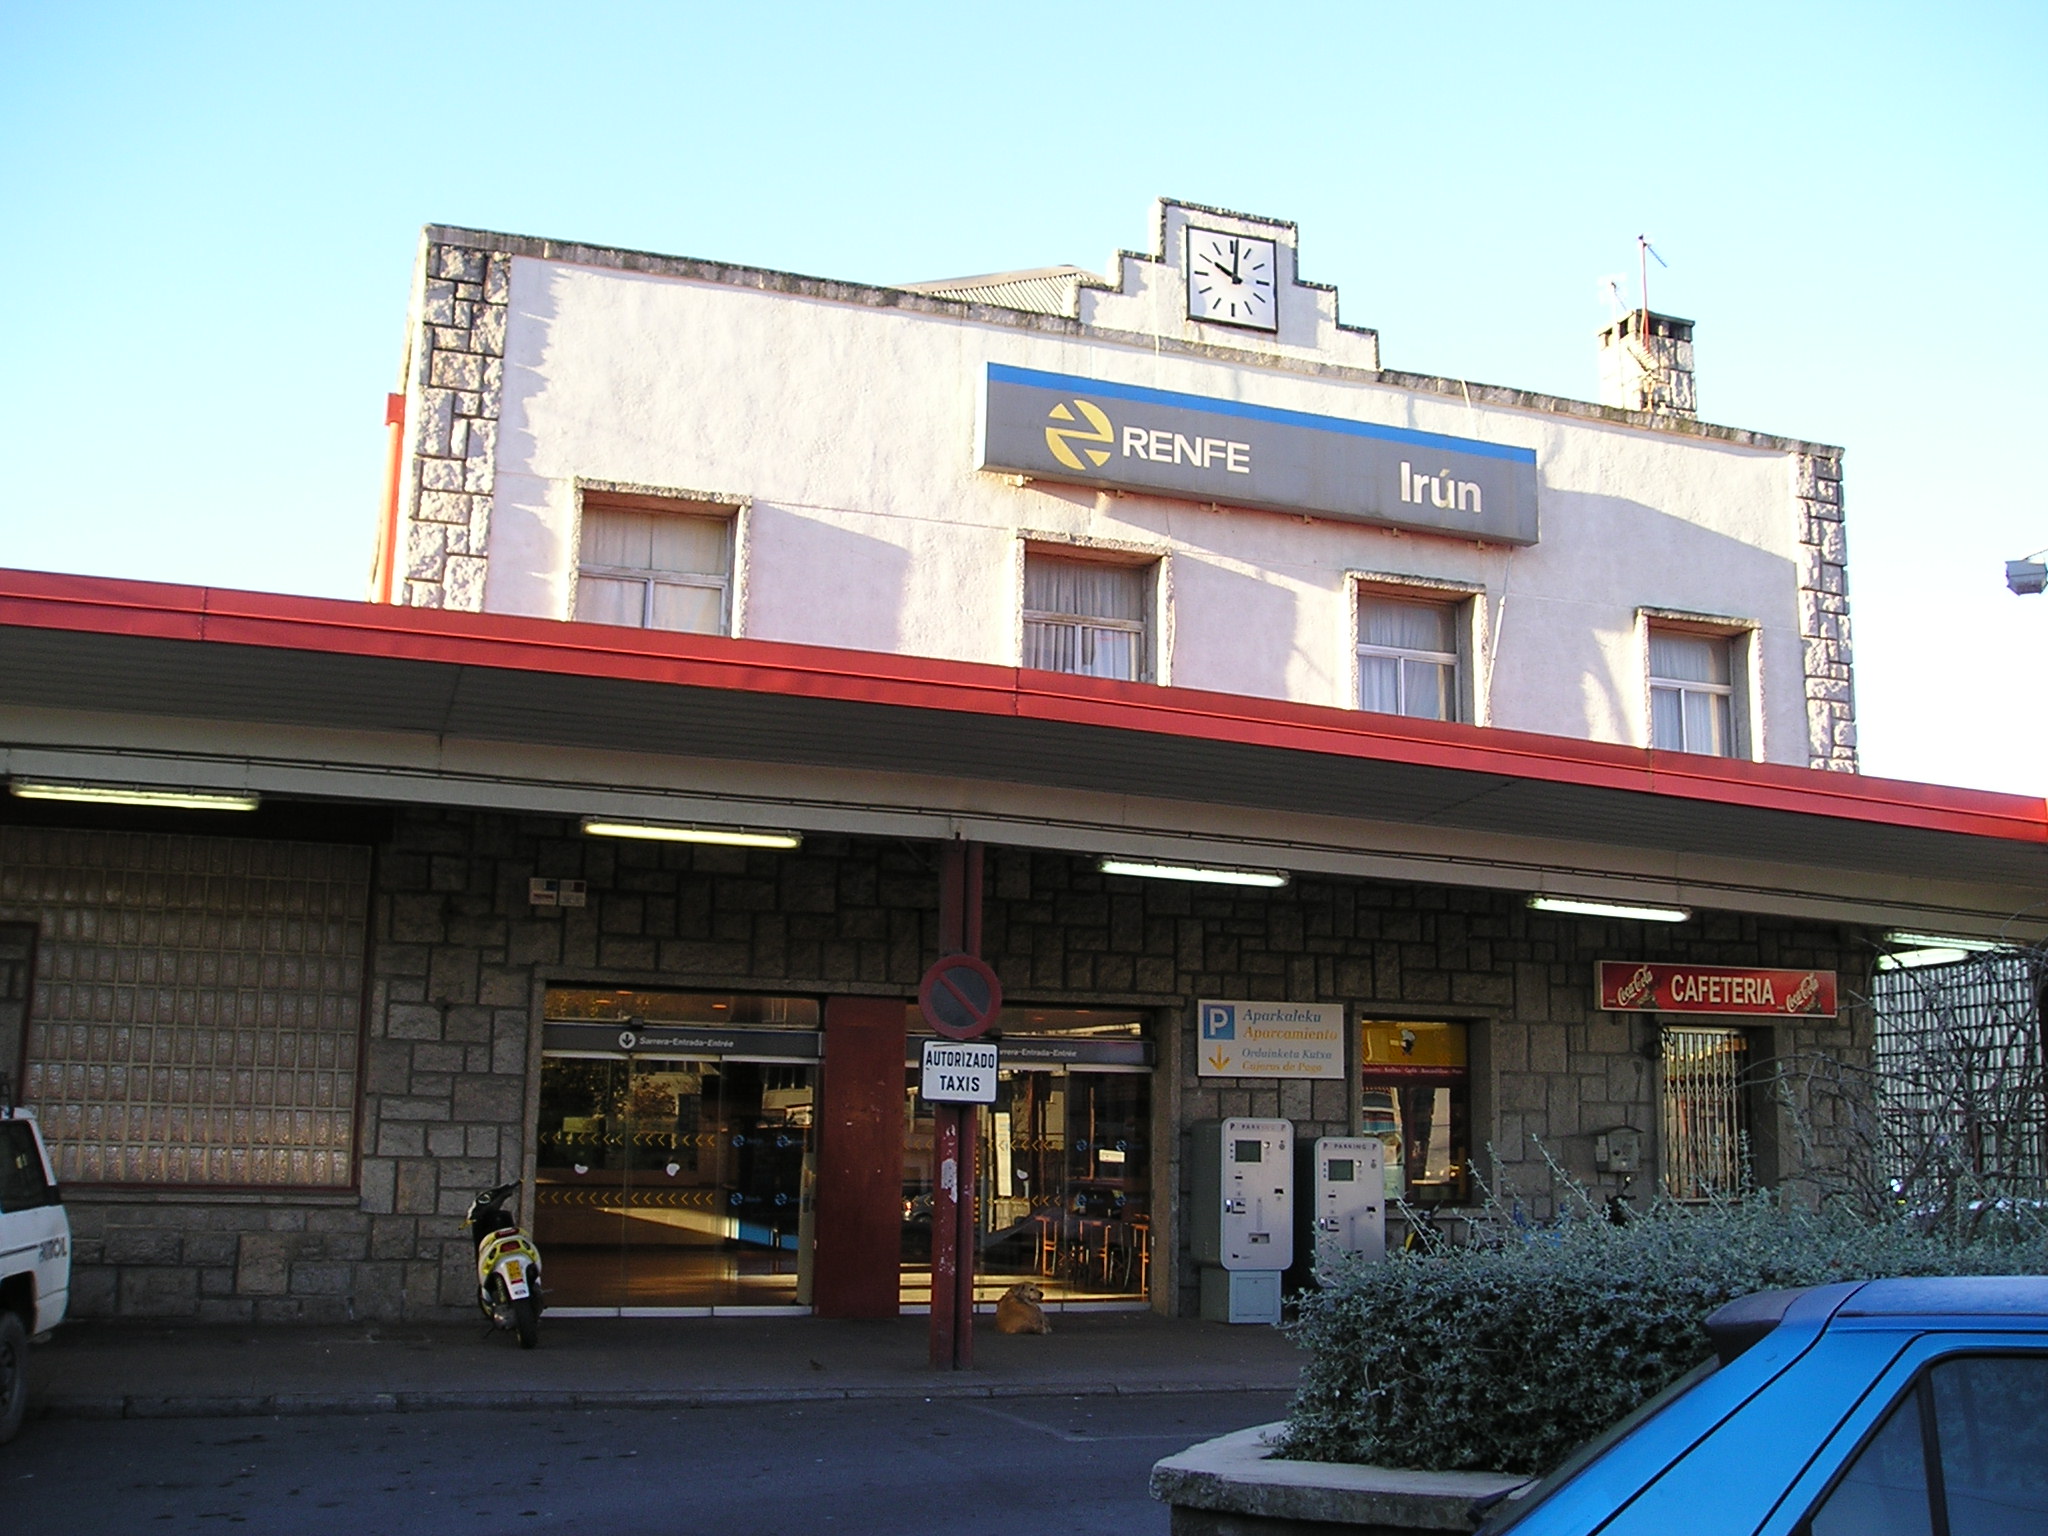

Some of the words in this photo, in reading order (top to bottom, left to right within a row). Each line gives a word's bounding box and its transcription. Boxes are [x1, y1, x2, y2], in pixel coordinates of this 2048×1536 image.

[1123, 425, 1250, 474] RENFE
[1400, 460, 1482, 513] Irún
[1671, 974, 1776, 1006] CAFETERIA
[1209, 1008, 1229, 1036] P
[1243, 1009, 1322, 1025] Aparkaleku
[1243, 1026, 1338, 1042] Aparcamiento
[926, 1050, 995, 1069] AUTORIZADO
[1282, 1061, 1297, 1072] de
[940, 1074, 981, 1092] TAXIS
